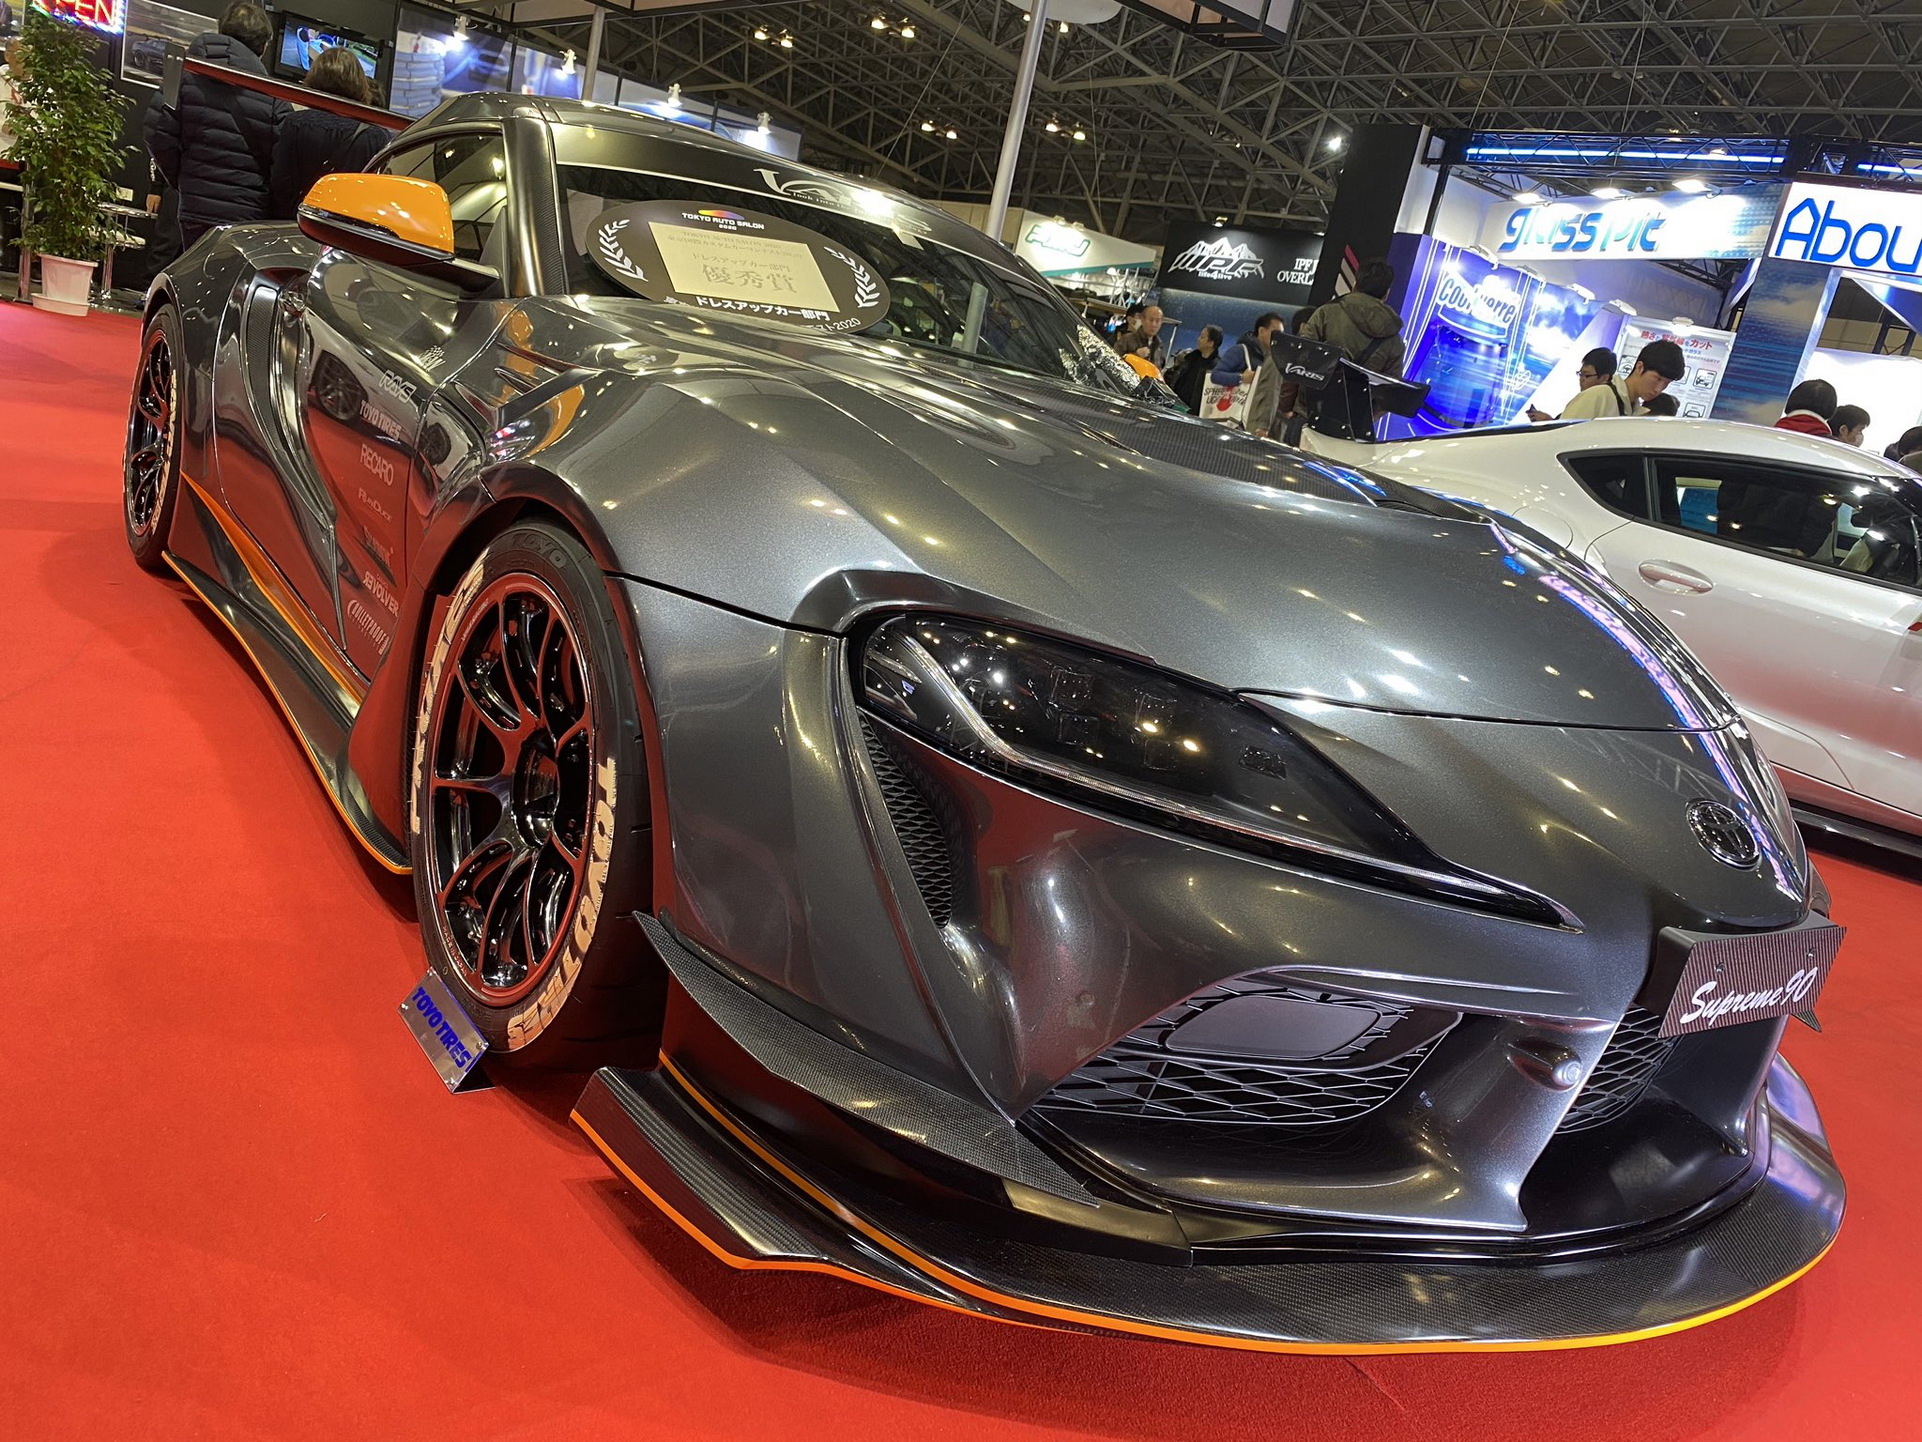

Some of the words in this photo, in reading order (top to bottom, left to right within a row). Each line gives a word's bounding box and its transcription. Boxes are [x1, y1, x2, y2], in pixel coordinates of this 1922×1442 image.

[682, 212, 711, 222] TOKYO
[712, 217, 736, 226] AUTO
[736, 220, 765, 230] SALON
[702, 263, 797, 294] 優秀賞
[1293, 257, 1312, 271] IPF
[696, 296, 831, 322] ドレスアップカー部門
[378, 369, 417, 403] RAYS
[360, 399, 380, 425] TOYO
[379, 411, 402, 441] TIRES
[360, 443, 394, 487] RECARO
[363, 570, 399, 618] REVOLVER
[575, 756, 617, 953] TOYO
[412, 986, 444, 1029] TOYO
[435, 1021, 472, 1068] TIRES
